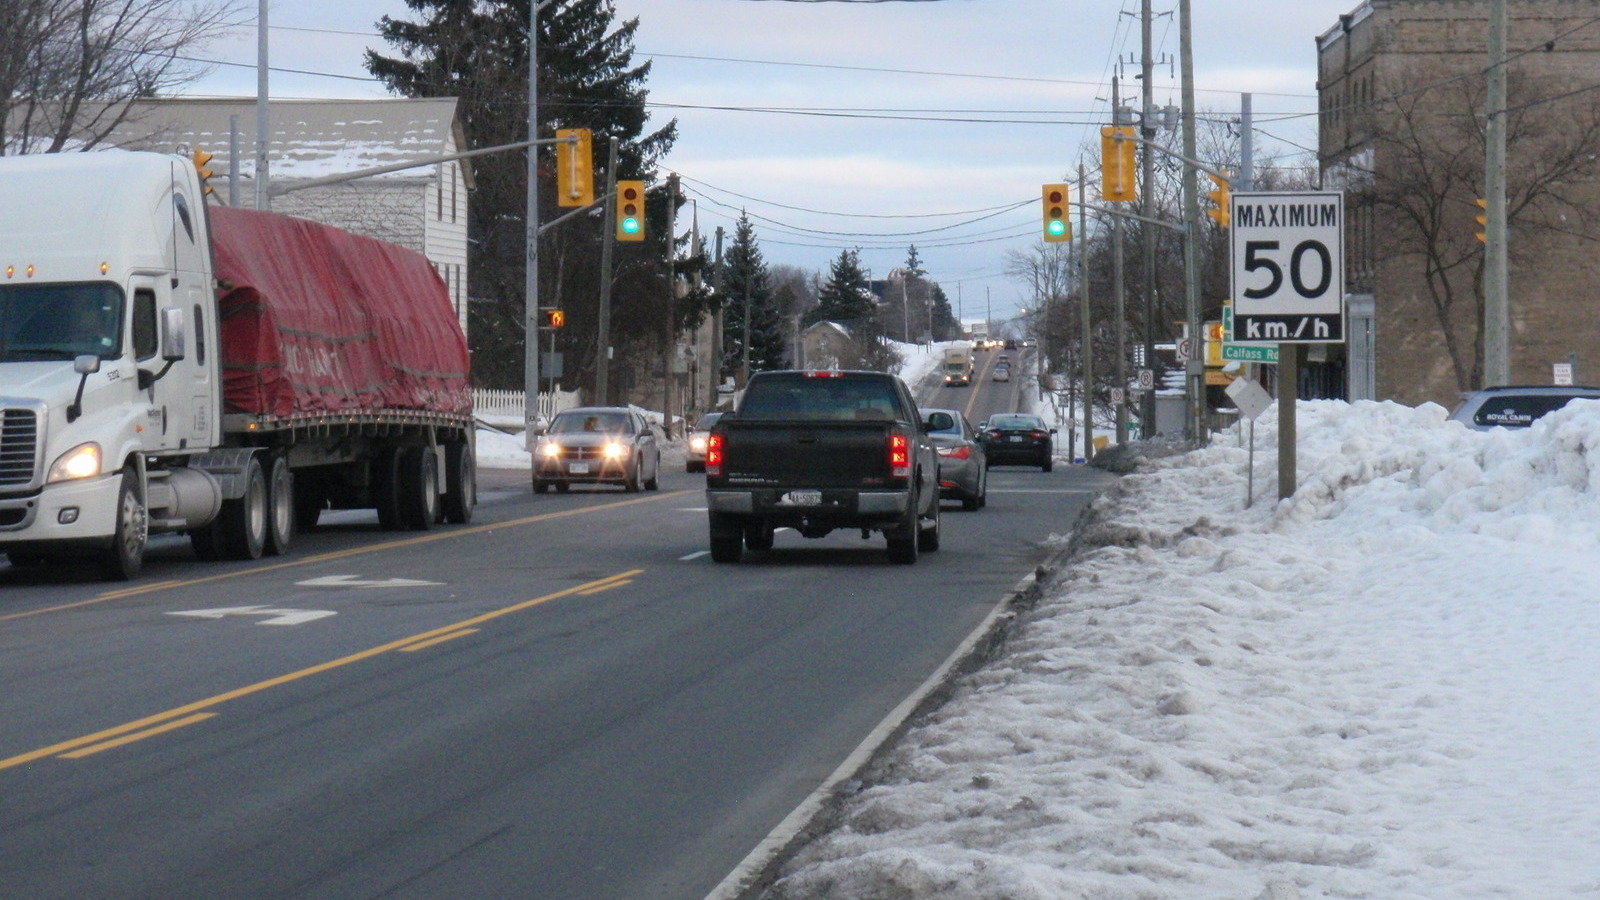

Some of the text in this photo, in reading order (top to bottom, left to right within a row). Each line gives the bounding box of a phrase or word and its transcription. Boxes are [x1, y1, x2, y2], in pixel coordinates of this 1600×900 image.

[1237, 204, 1336, 227] MAXIMUM
[1243, 239, 1332, 299] 50
[1246, 317, 1329, 338] km/h
[1226, 346, 1261, 359] Calfass
